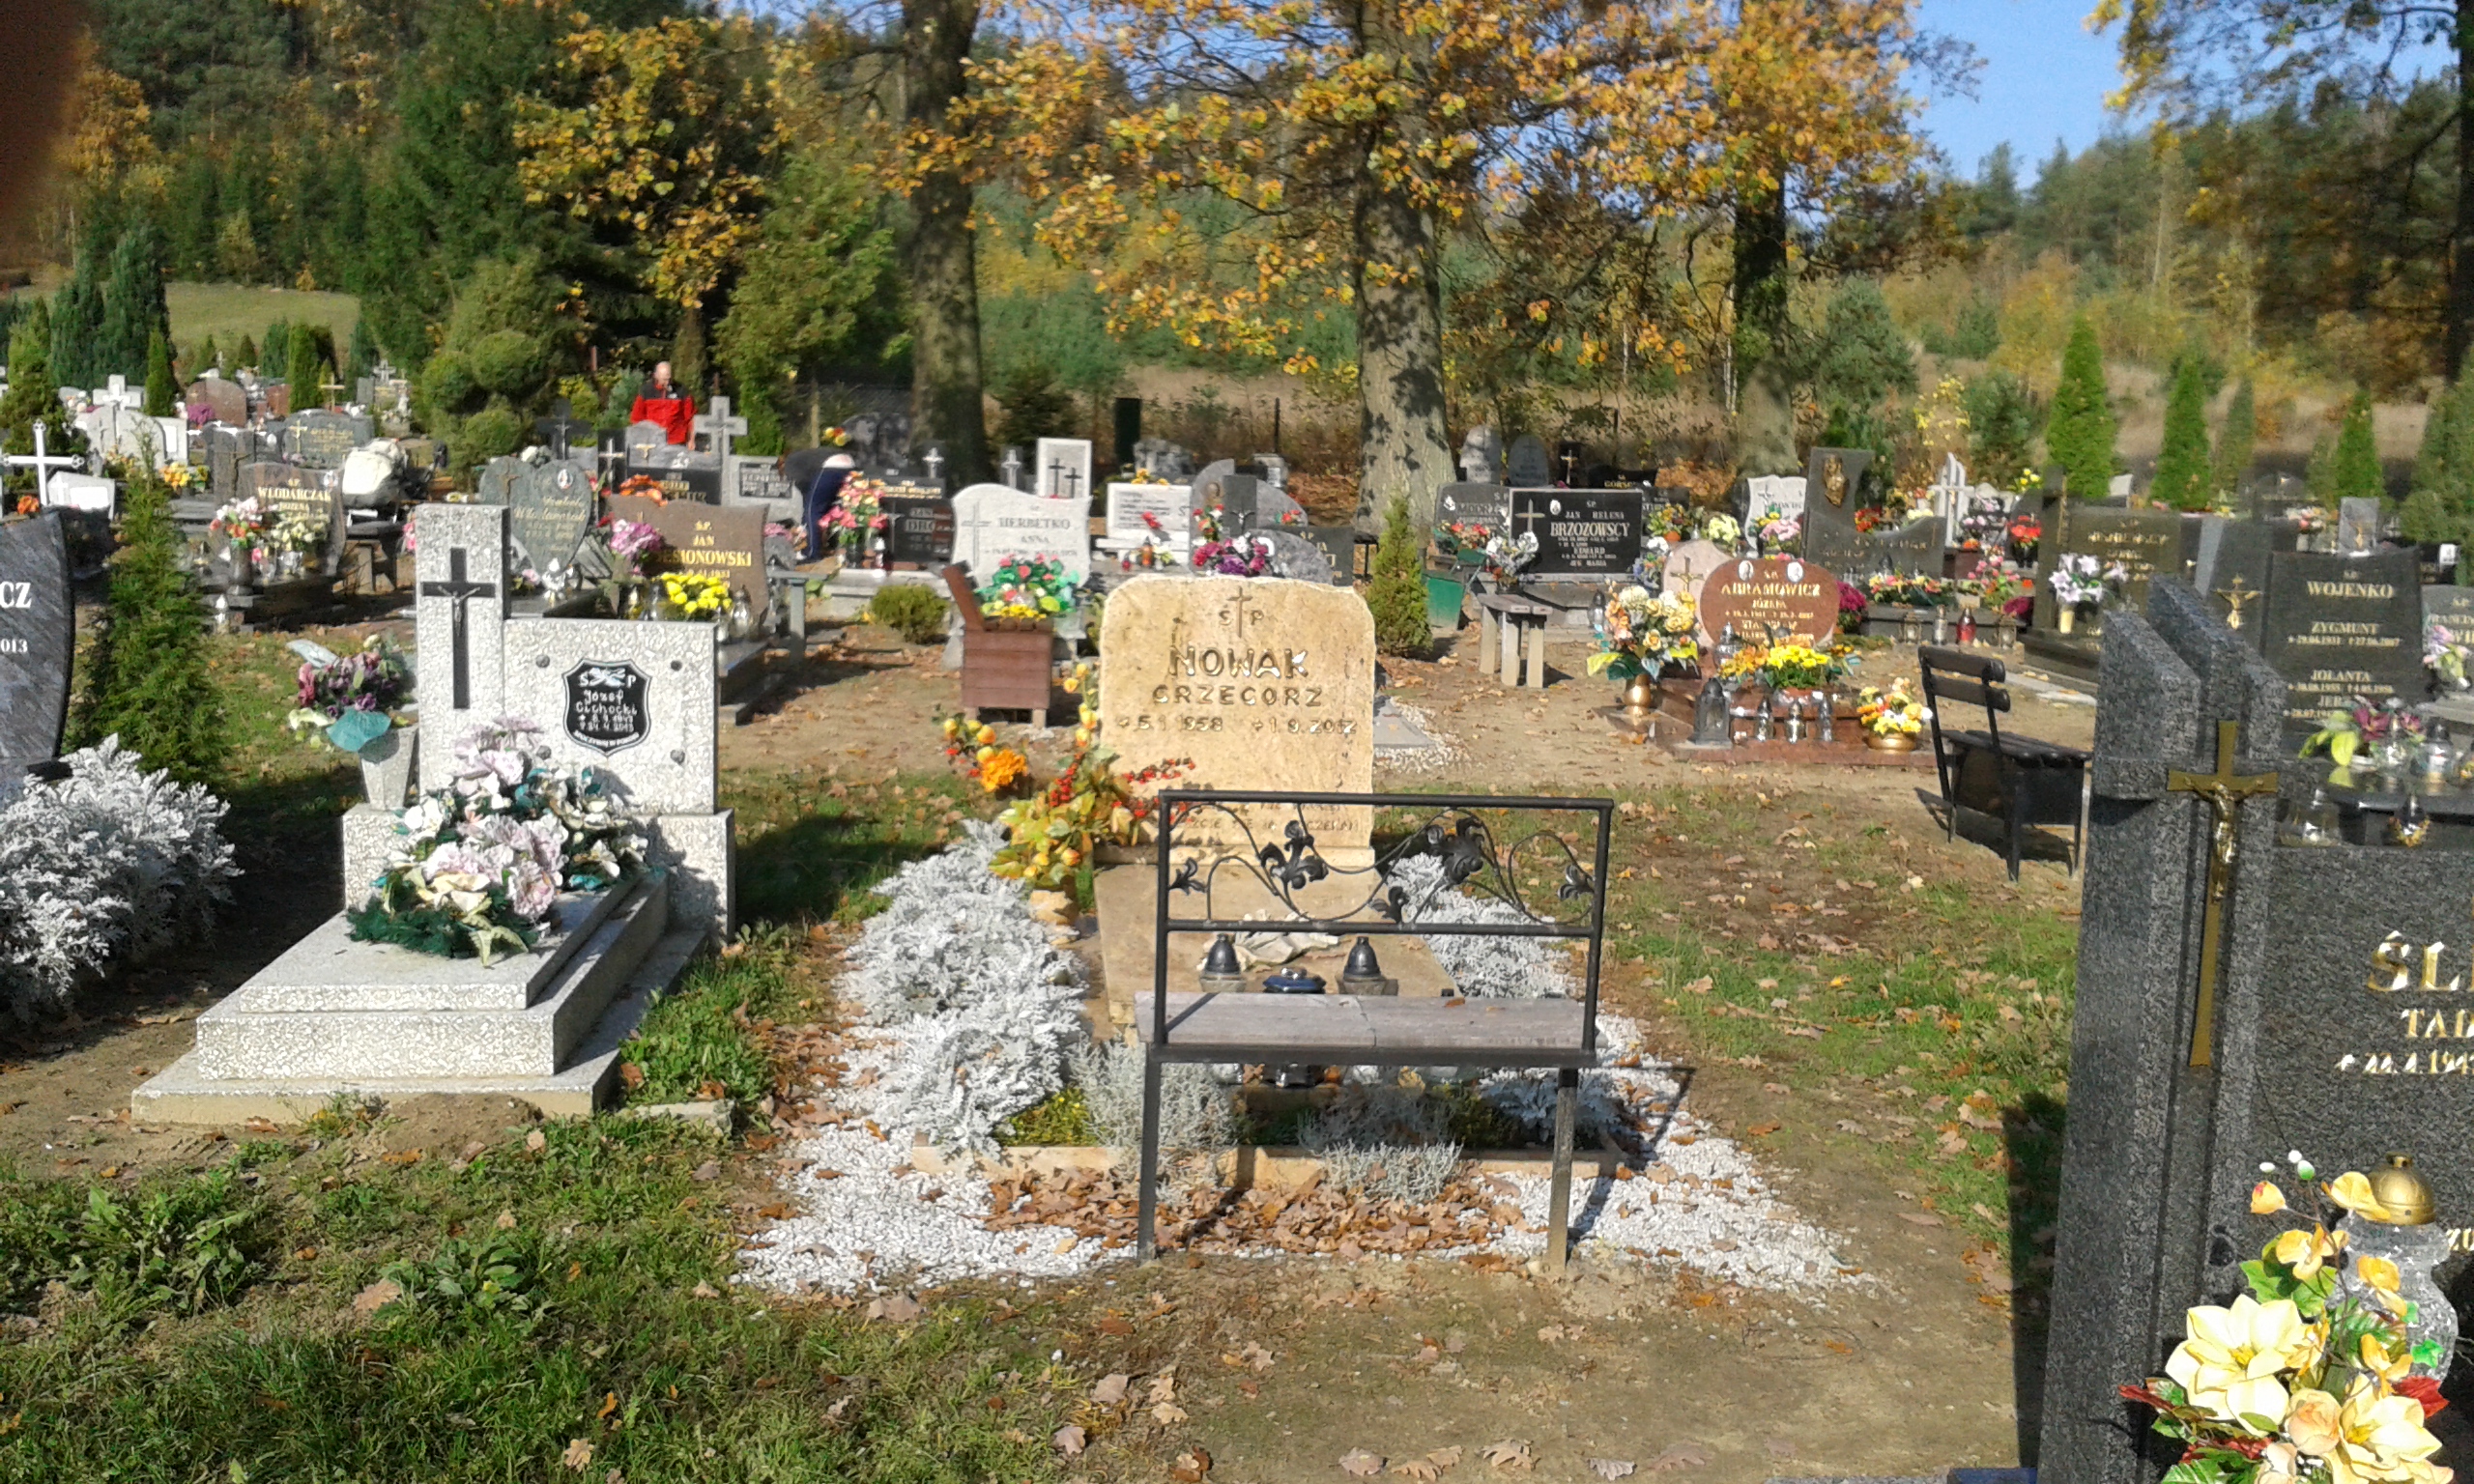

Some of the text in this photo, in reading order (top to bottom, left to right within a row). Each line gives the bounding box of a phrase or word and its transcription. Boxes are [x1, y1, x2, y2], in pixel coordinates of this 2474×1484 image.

[1549, 521, 1631, 537] BRZOZOWSCY
[693, 534, 716, 548] JAN
[1720, 583, 1821, 597] ABRAMOWICZ
[2306, 580, 2394, 599] WOJENKO
[1250, 609, 1265, 627] P
[2311, 620, 2379, 635] ZYGMUNT
[1167, 645, 1309, 679] NOWAK
[2310, 670, 2372, 683] JOLANTA
[1151, 683, 1322, 707] GRZEGORZ
[2366, 929, 2474, 992] ŚL
